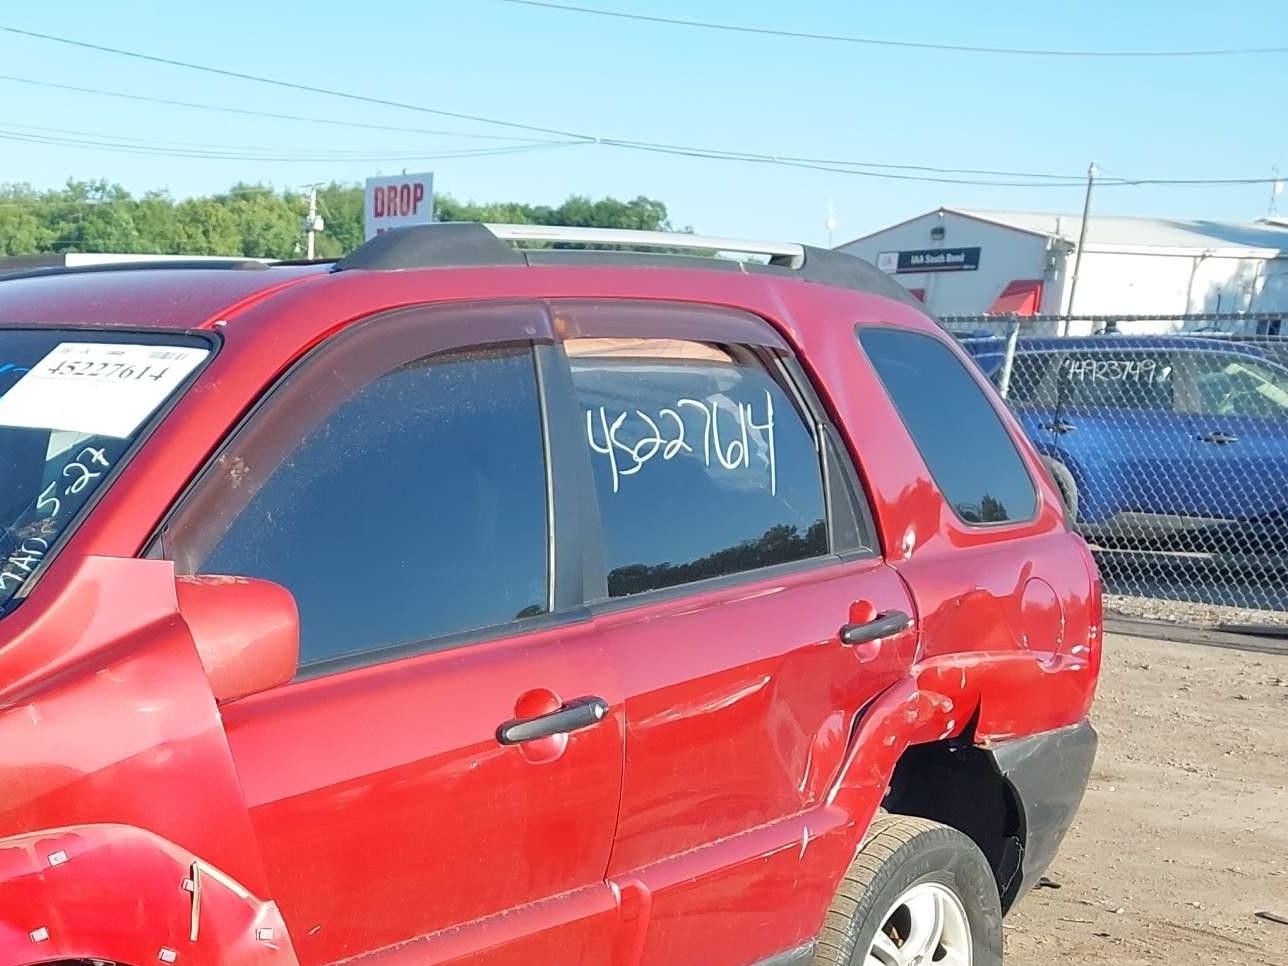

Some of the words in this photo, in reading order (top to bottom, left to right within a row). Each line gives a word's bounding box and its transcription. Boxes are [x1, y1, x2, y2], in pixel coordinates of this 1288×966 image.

[374, 183, 424, 218] DROP
[48, 359, 169, 382] 45227614
[586, 389, 776, 496] 45227614
